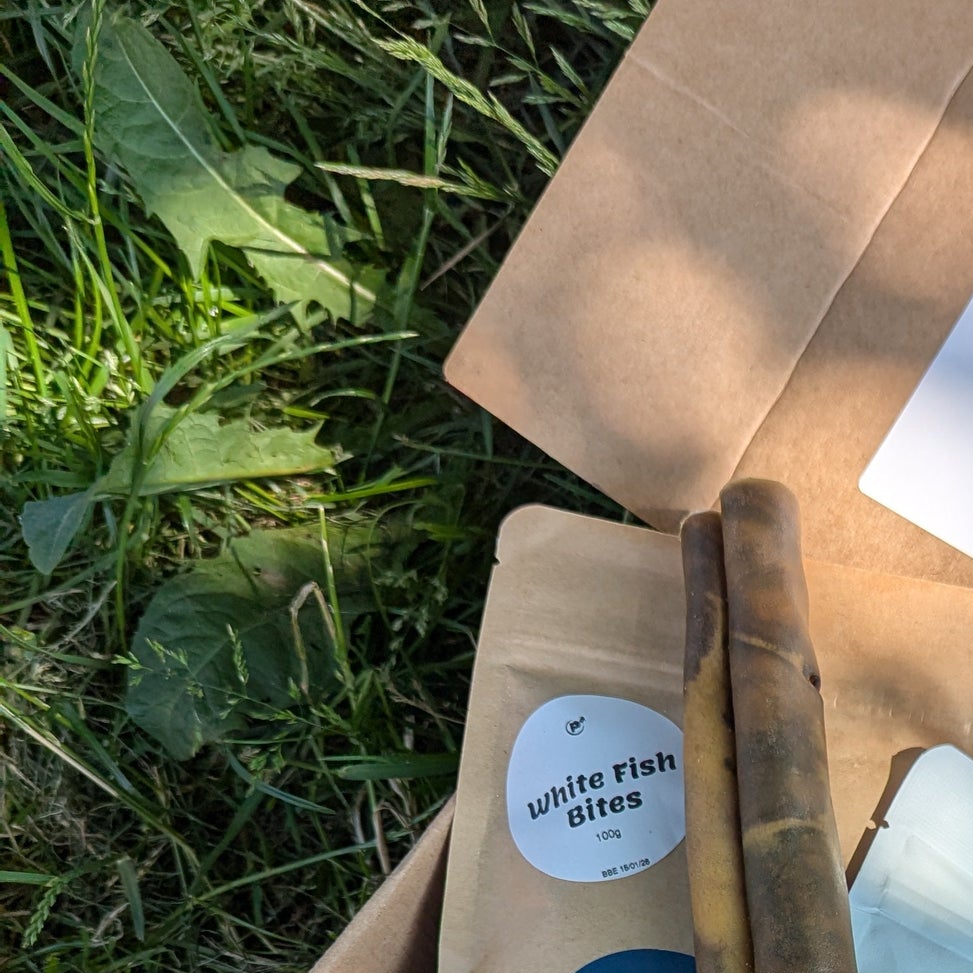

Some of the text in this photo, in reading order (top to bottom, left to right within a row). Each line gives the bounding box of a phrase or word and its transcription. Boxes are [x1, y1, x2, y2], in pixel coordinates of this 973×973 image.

[527, 752, 677, 820] White Fish
[567, 790, 643, 828] Bites
[596, 828, 622, 842] 100g
[601, 867, 619, 878] BBE
